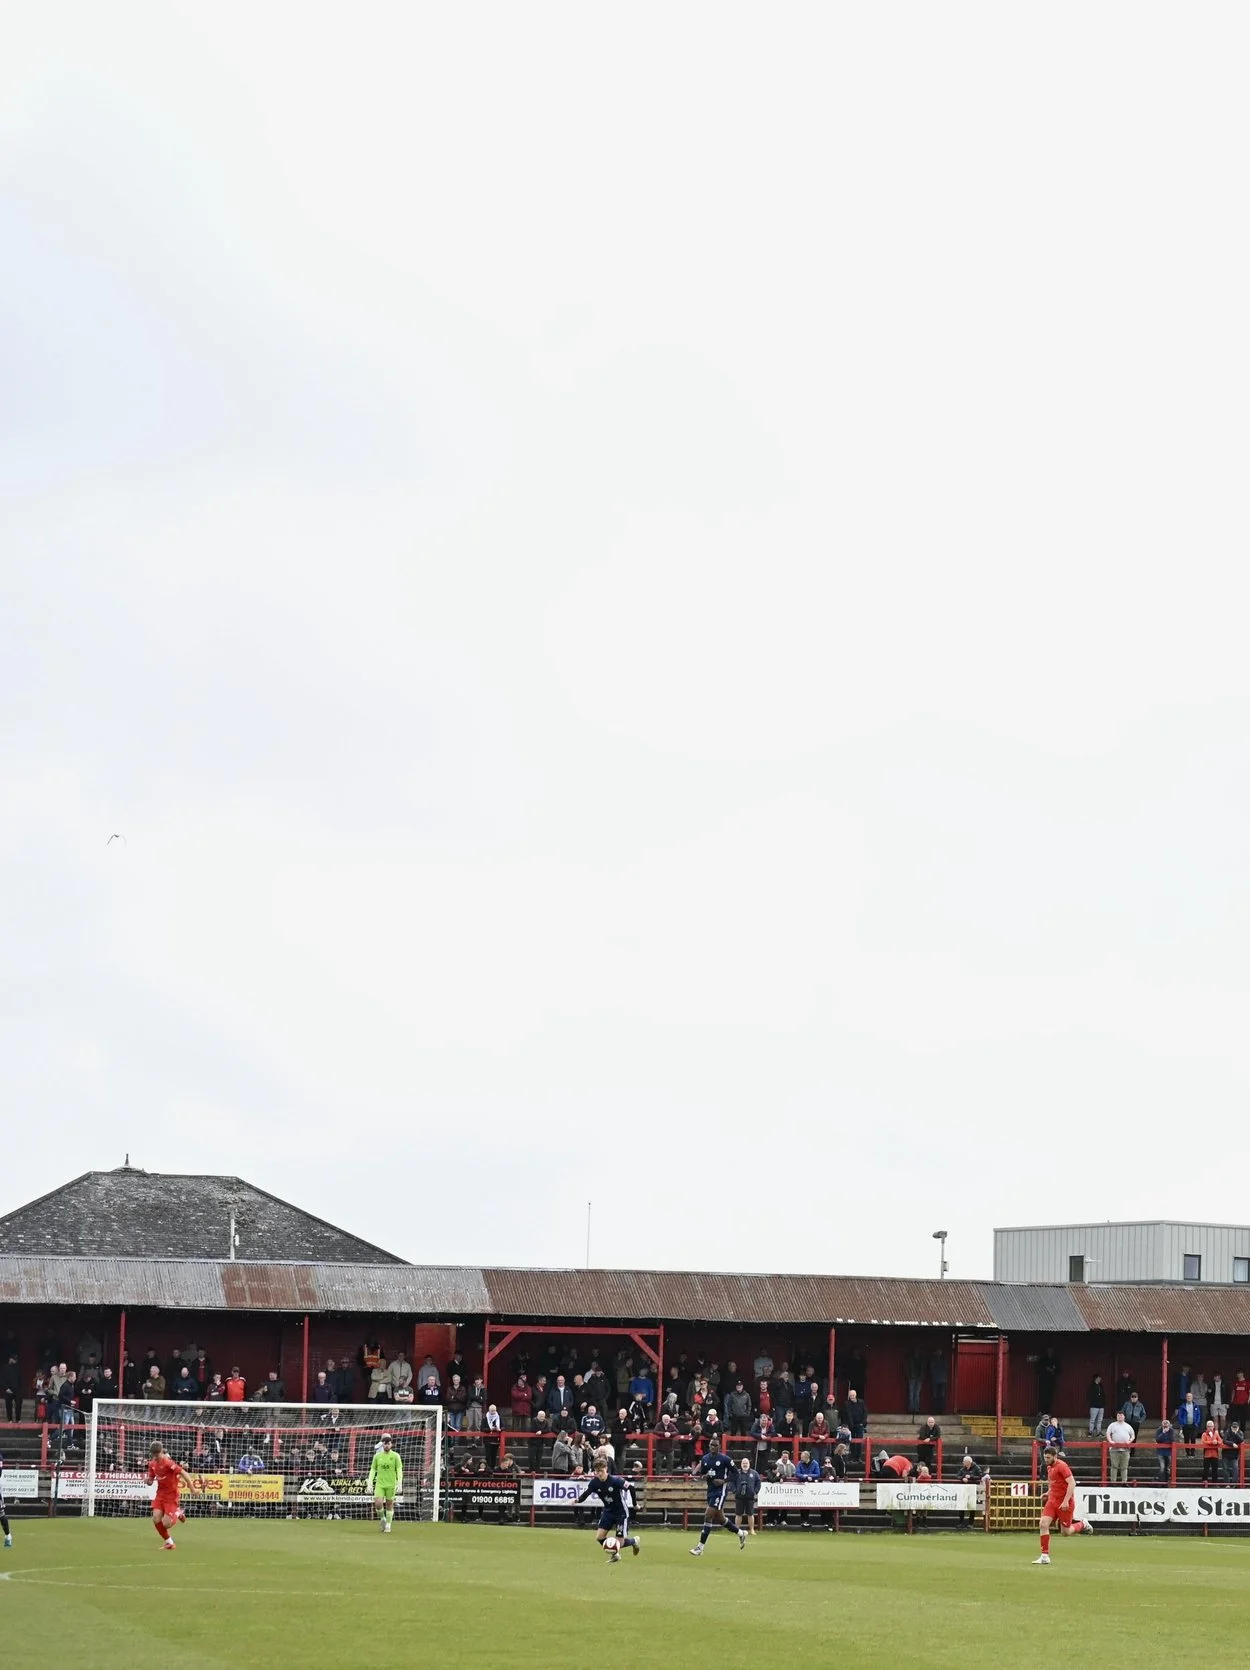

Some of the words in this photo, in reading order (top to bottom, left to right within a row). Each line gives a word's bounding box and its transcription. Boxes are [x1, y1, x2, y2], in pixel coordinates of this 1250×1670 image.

[473, 1480, 518, 1488] Protection
[765, 1486, 804, 1494] Milburns
[1012, 1484, 1026, 1496] 11
[228, 1491, 253, 1499] 01900
[896, 1493, 958, 1501] Cumberland
[494, 1496, 515, 1504] 66815
[1082, 1494, 1166, 1515] Times
[1172, 1501, 1189, 1516] &
